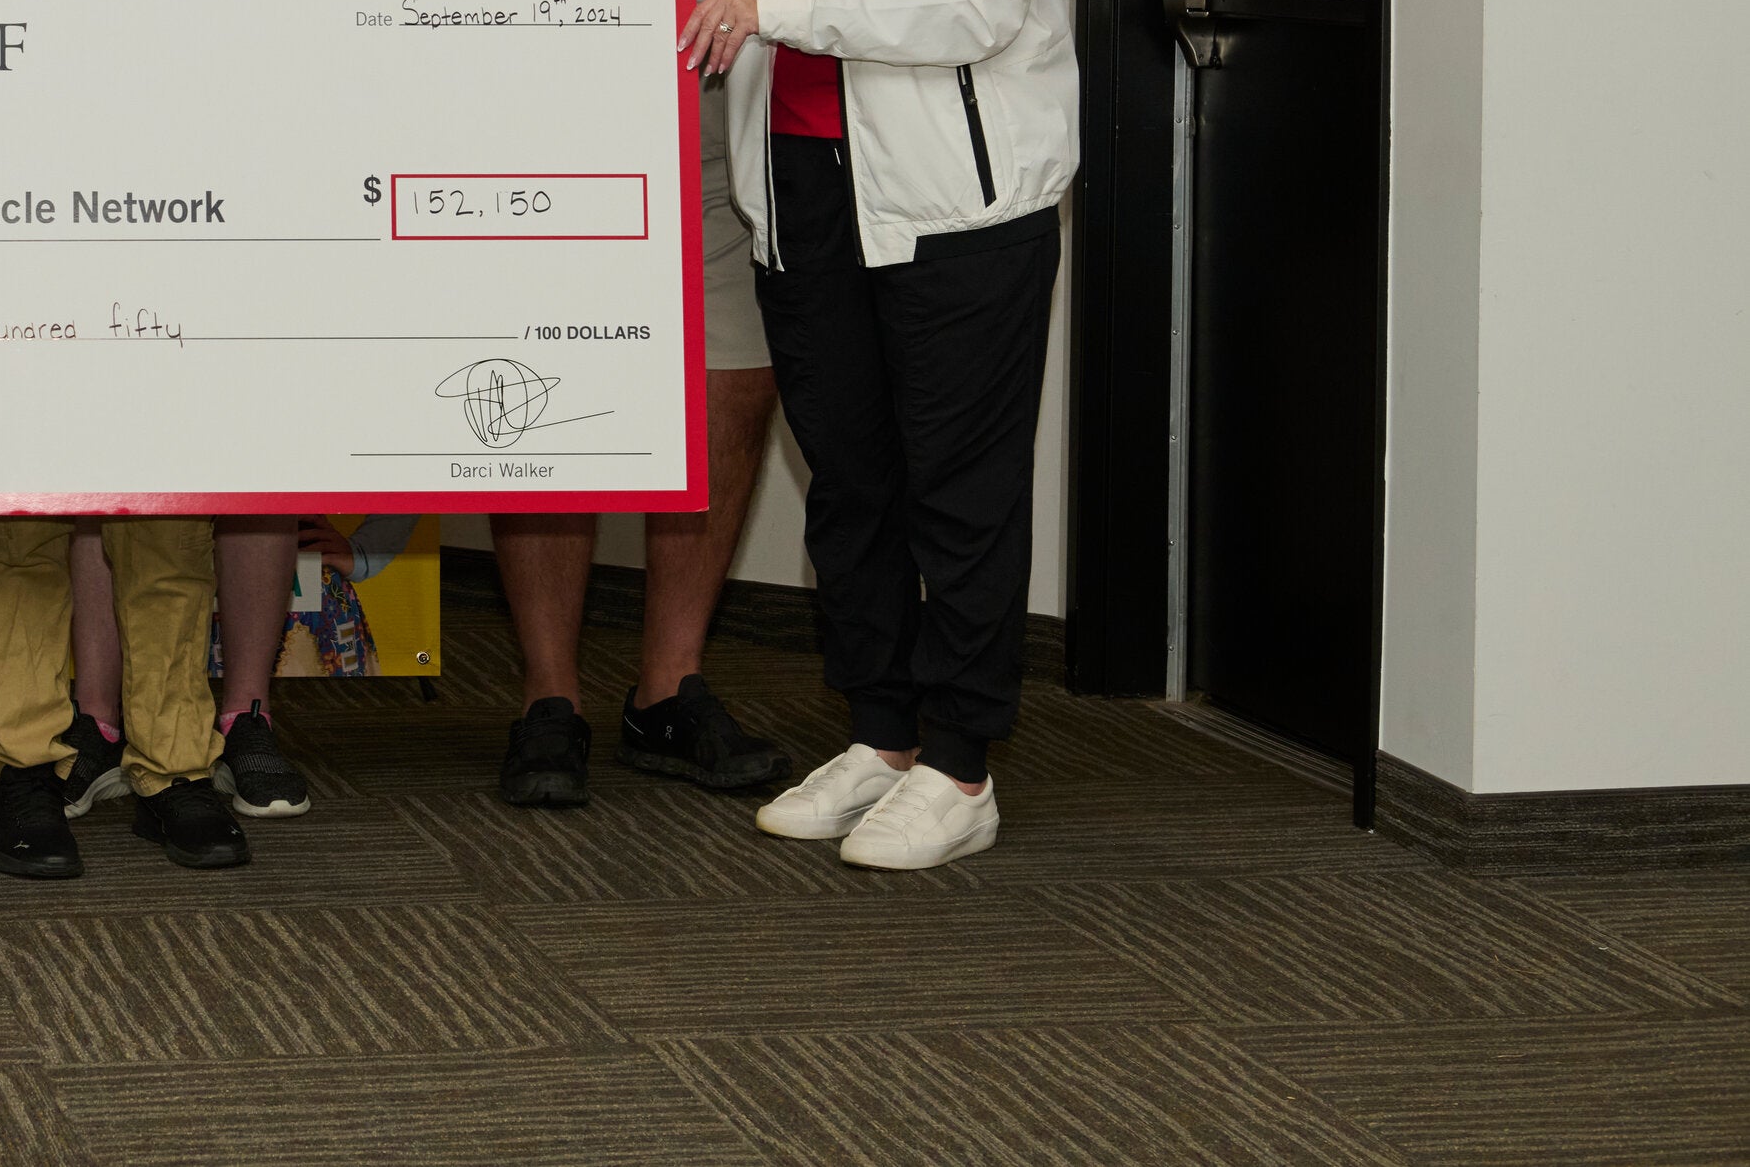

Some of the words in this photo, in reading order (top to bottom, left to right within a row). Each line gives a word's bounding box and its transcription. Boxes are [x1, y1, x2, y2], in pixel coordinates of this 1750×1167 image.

[355, 11, 393, 28] Date
[574, 5, 622, 28] 2024
[363, 174, 382, 207] $
[412, 187, 554, 220] 152,150
[72, 190, 226, 225] Network
[108, 302, 184, 348] fifty
[523, 325, 531, 342] /
[534, 325, 562, 342] 100
[566, 325, 651, 342] DOLLARS
[450, 462, 493, 480] Darci
[498, 462, 555, 480] Walker
